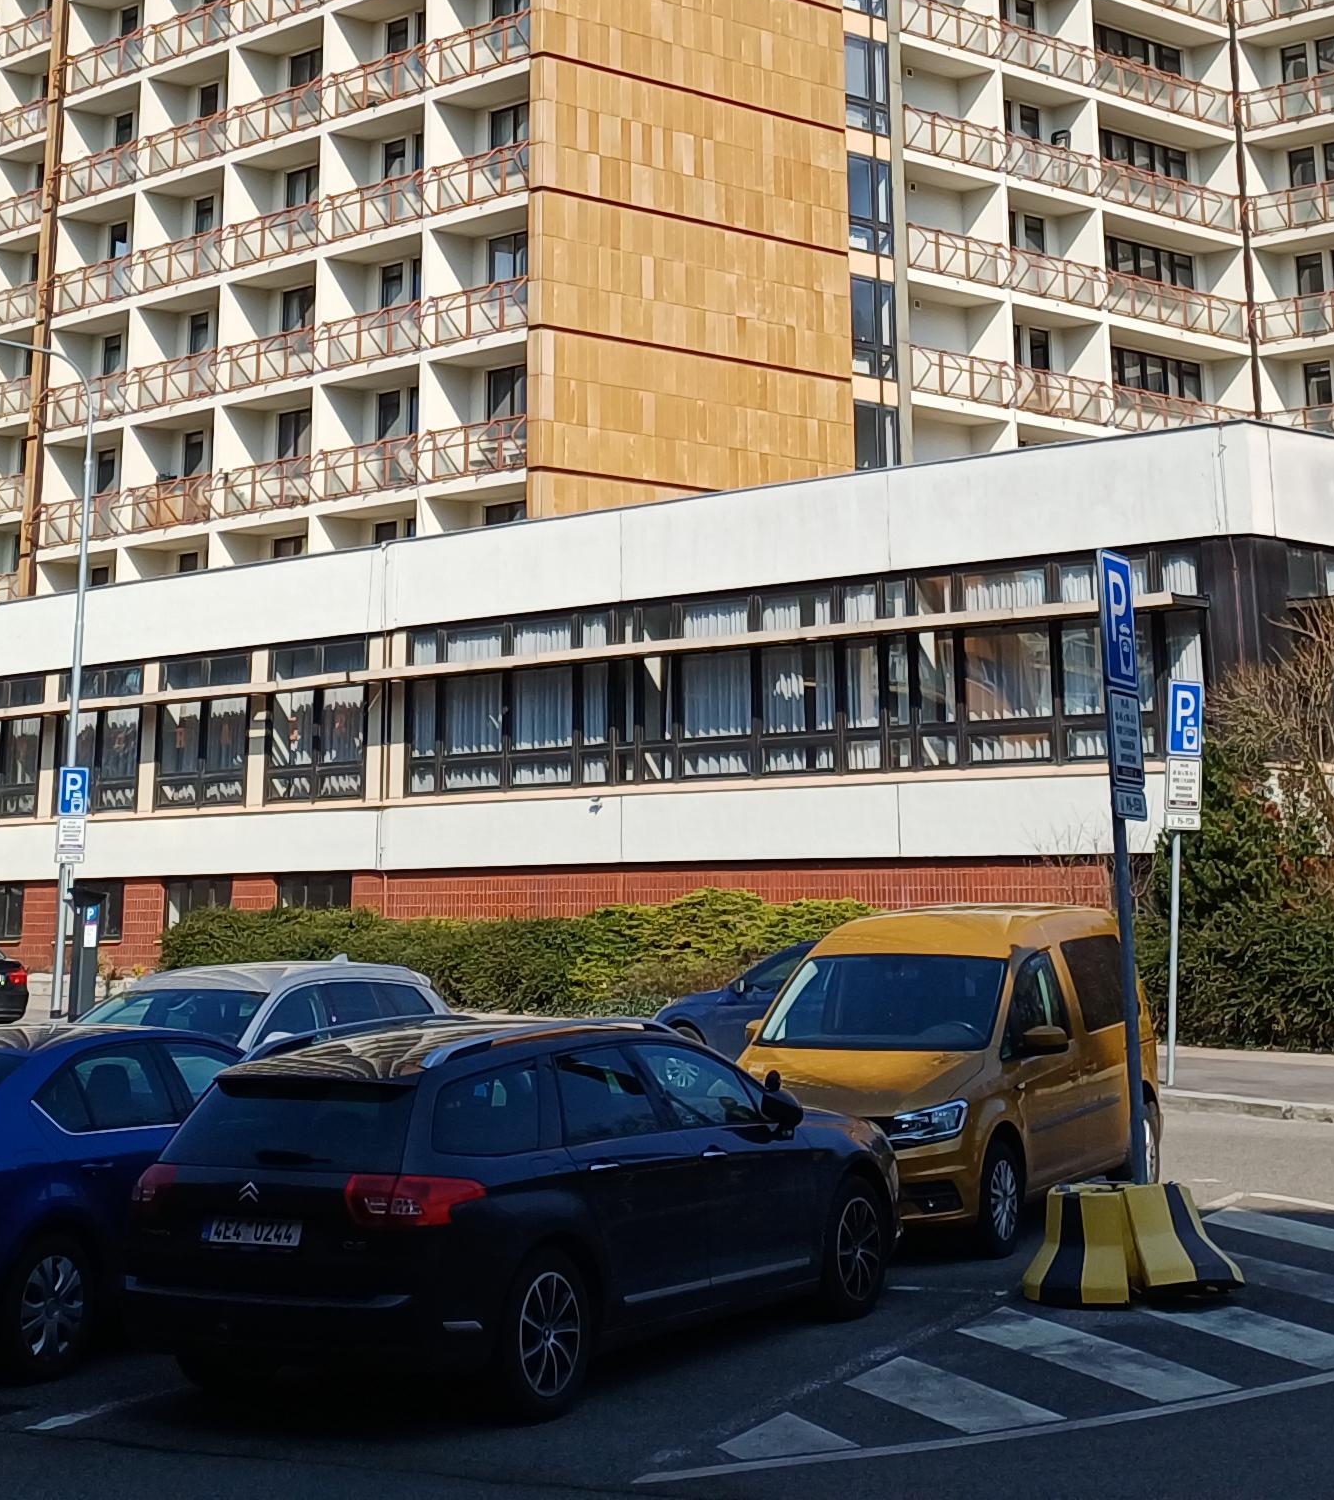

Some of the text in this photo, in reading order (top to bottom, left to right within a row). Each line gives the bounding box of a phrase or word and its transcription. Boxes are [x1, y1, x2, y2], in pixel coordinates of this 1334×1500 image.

[1107, 569, 1126, 642] P
[1176, 690, 1196, 732] P
[65, 773, 83, 801] P
[86, 907, 95, 921] P
[213, 1220, 293, 1243] 4E4 0244
